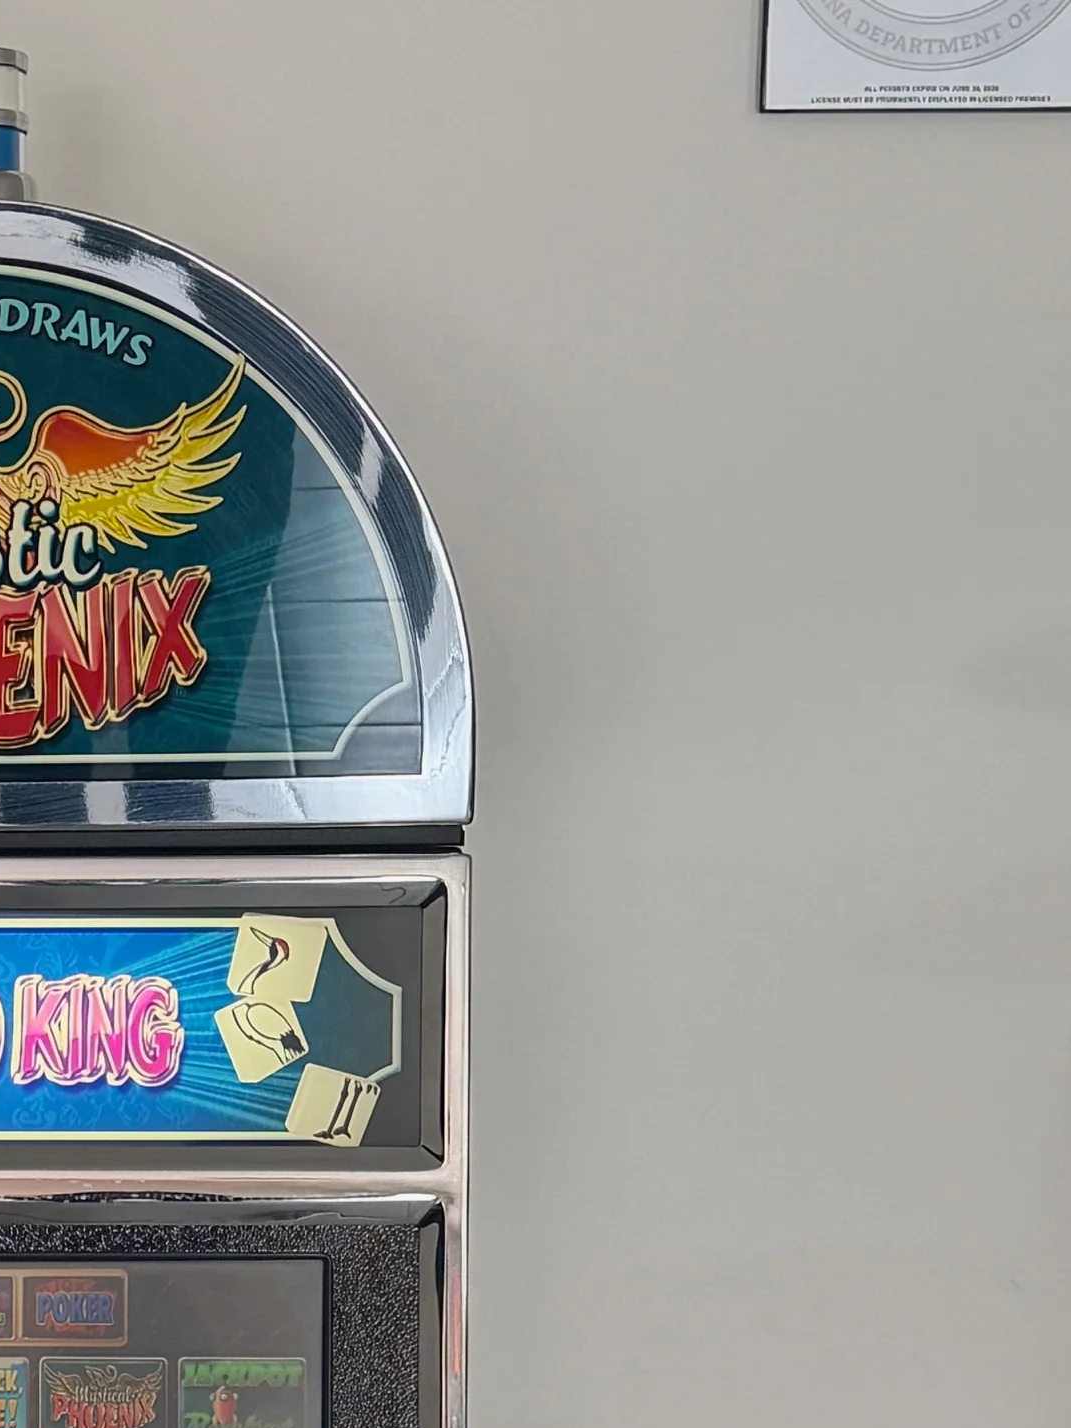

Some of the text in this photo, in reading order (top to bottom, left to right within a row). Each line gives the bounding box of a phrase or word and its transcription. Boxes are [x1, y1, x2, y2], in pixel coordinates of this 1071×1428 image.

[854, 18, 1002, 54] DEPARTMENT
[1008, 5, 1036, 29] OF
[13, 975, 185, 1086] KING
[36, 1292, 115, 1325] POKER
